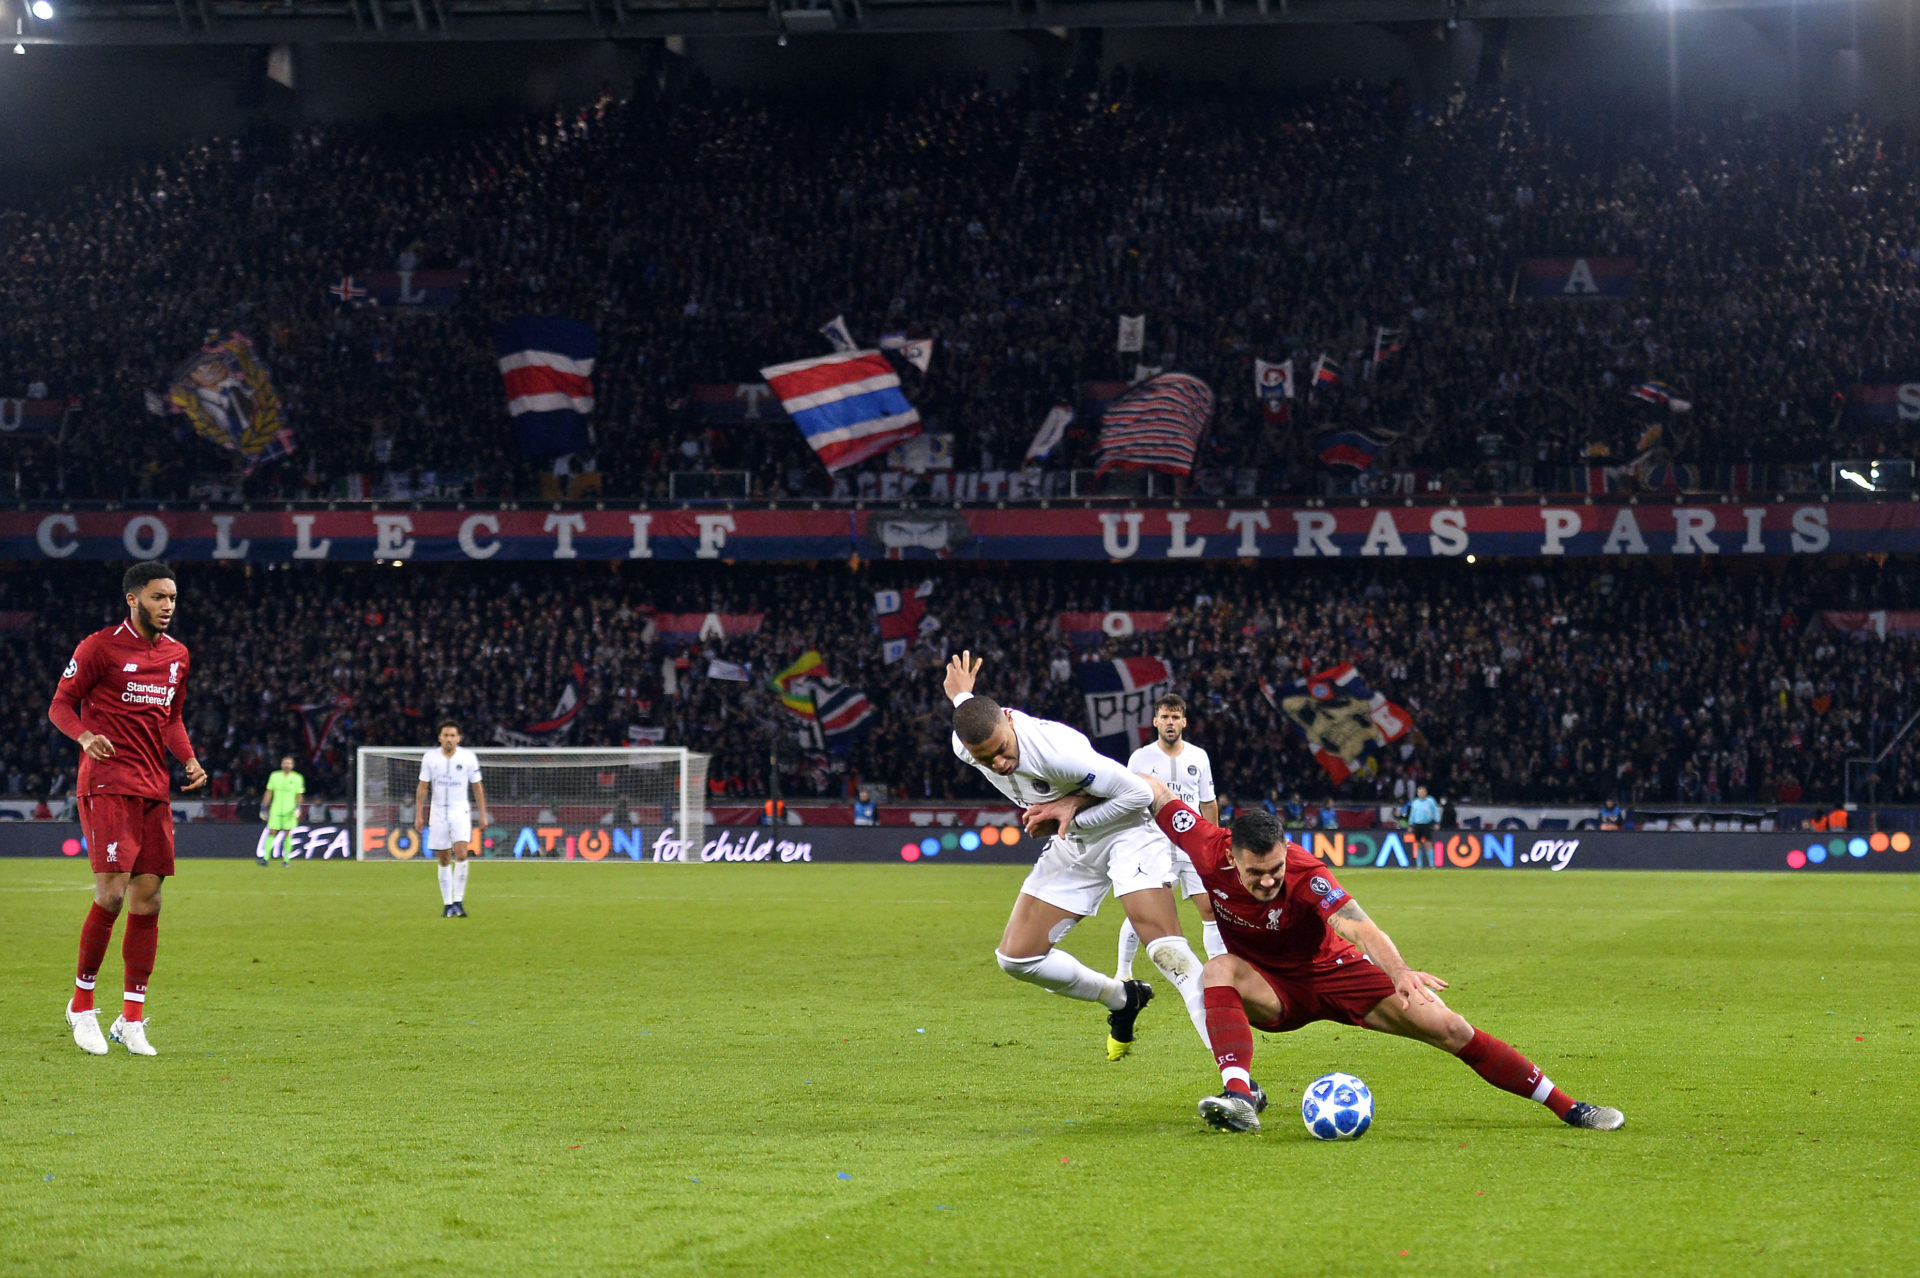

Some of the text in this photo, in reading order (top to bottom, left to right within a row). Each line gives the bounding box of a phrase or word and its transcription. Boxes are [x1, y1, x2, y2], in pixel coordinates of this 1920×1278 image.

[36, 507, 1831, 560] COLLECTIF ULTRAS PARIS
[126, 681, 167, 695] Standard
[121, 692, 166, 706] Chartered
[1167, 782, 1182, 791] Fly
[256, 826, 350, 860] UEFA
